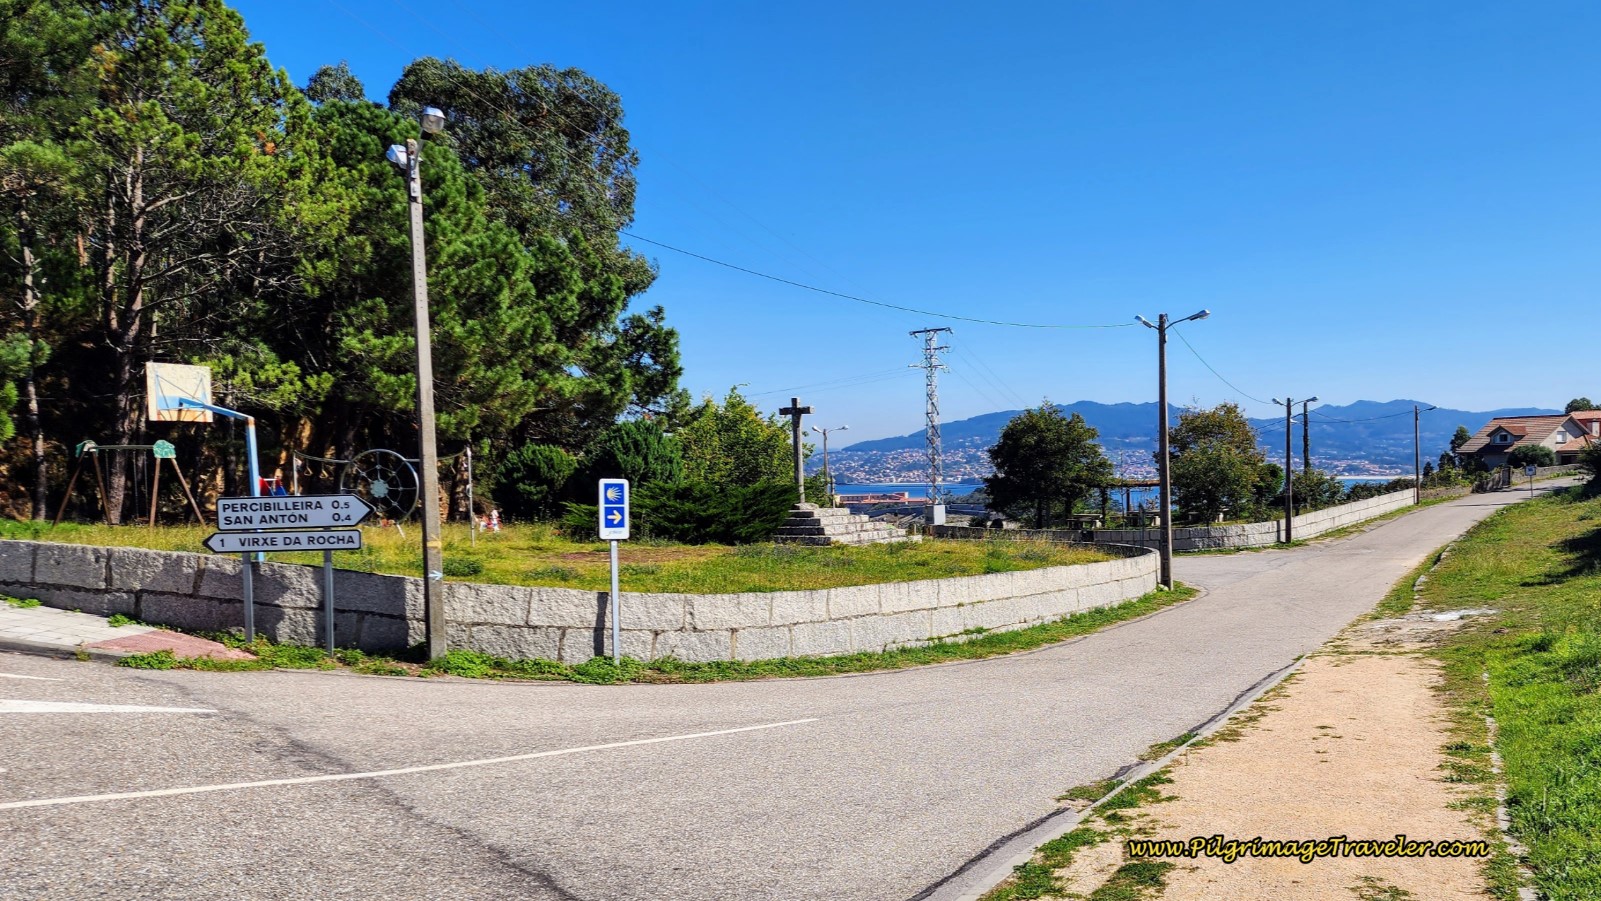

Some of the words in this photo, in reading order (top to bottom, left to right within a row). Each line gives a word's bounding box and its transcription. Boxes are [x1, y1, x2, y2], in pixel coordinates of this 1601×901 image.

[222, 500, 323, 513] PERCIBILLEIRA
[331, 500, 350, 510] 0.5
[223, 515, 253, 525] SAN
[259, 512, 308, 524] ANTÓN
[332, 512, 352, 522] 0.4
[219, 538, 225, 548] 1
[238, 536, 278, 547] VIRXE
[283, 536, 302, 546] DA
[307, 535, 355, 545] ROCHA
